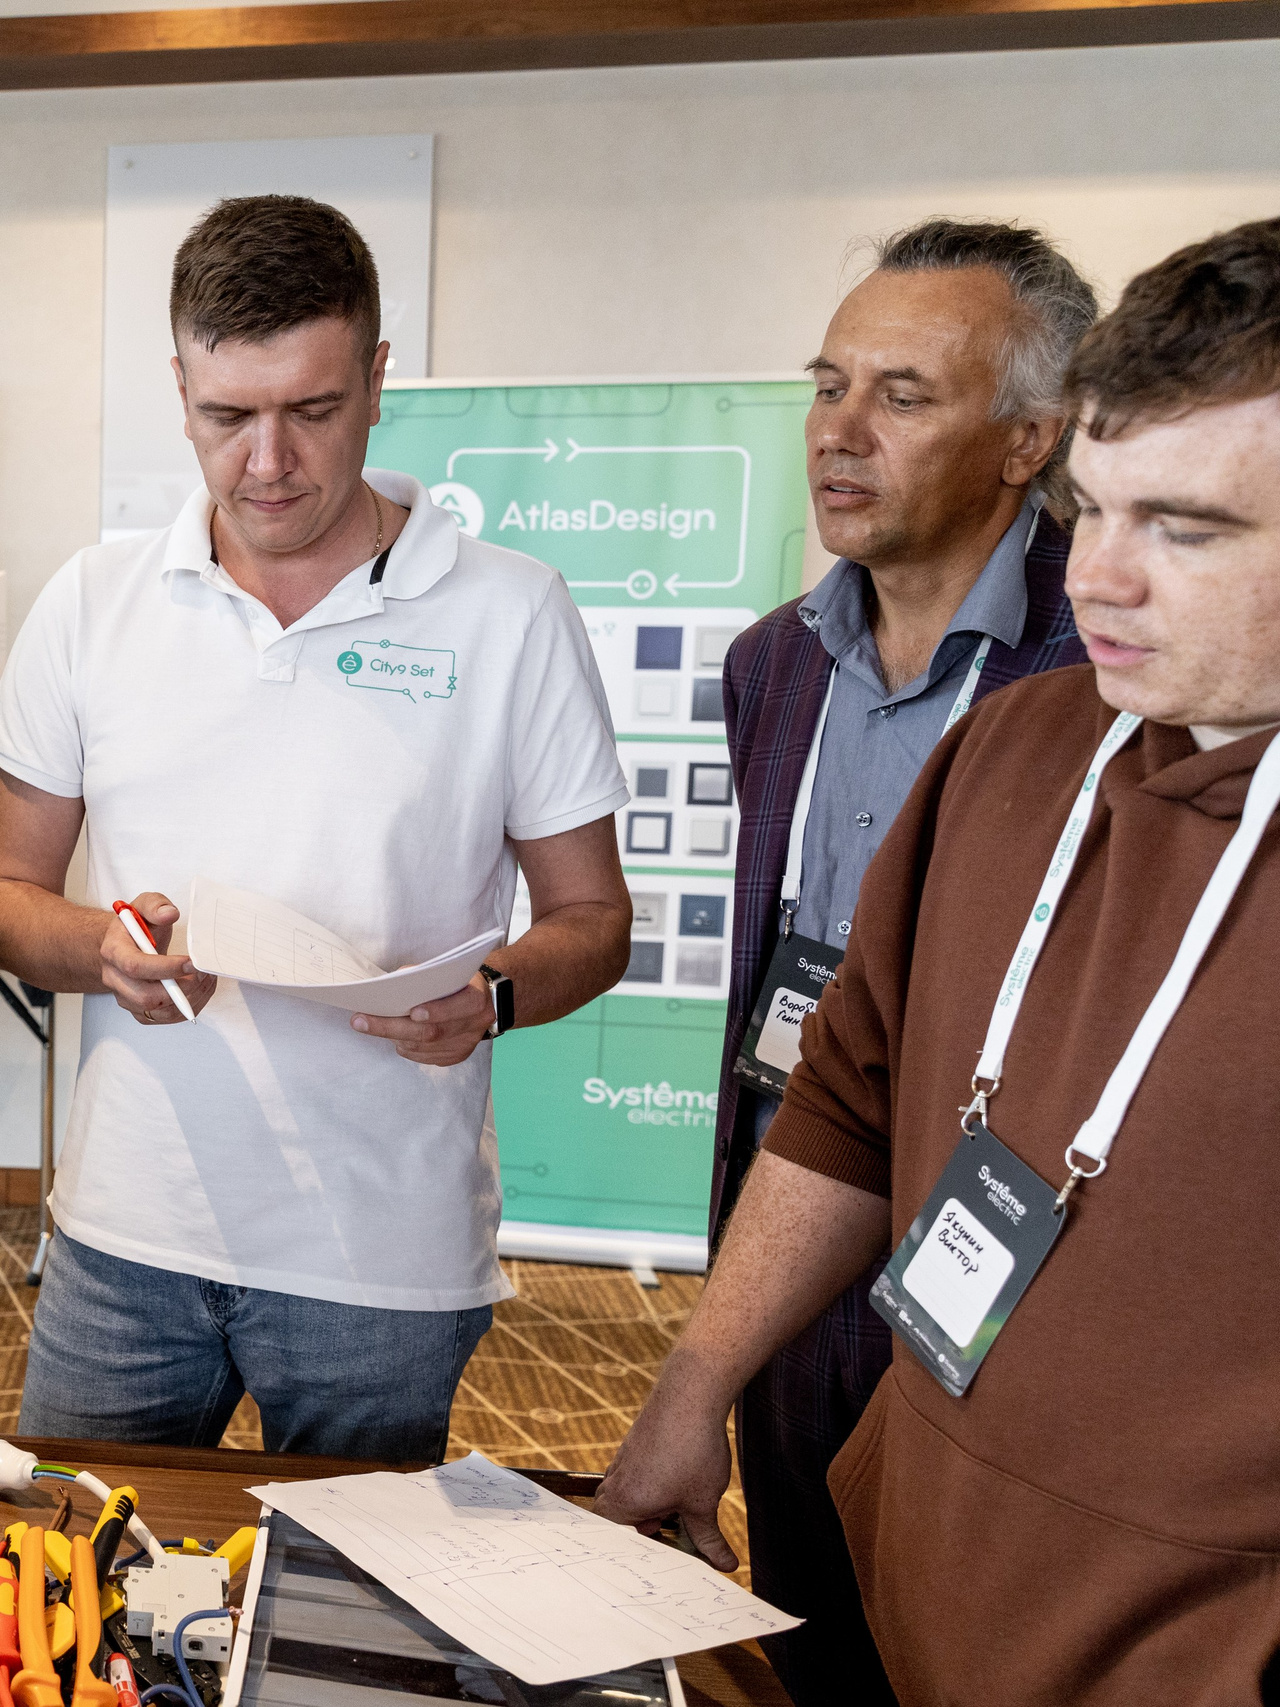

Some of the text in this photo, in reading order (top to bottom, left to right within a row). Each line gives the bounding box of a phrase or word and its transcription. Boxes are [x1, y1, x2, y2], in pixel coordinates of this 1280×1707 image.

[498, 500, 717, 539] AtlasDesign
[369, 658, 407, 678] City9
[410, 664, 435, 679] Set
[1050, 817, 1079, 878] Systême
[797, 957, 838, 980] Systêm
[1000, 946, 1029, 1007] Systême
[978, 1164, 1027, 1217] Systême
[987, 1190, 1021, 1226] electric
[938, 1228, 979, 1276] Виктор
[942, 1211, 984, 1254] Якунин
